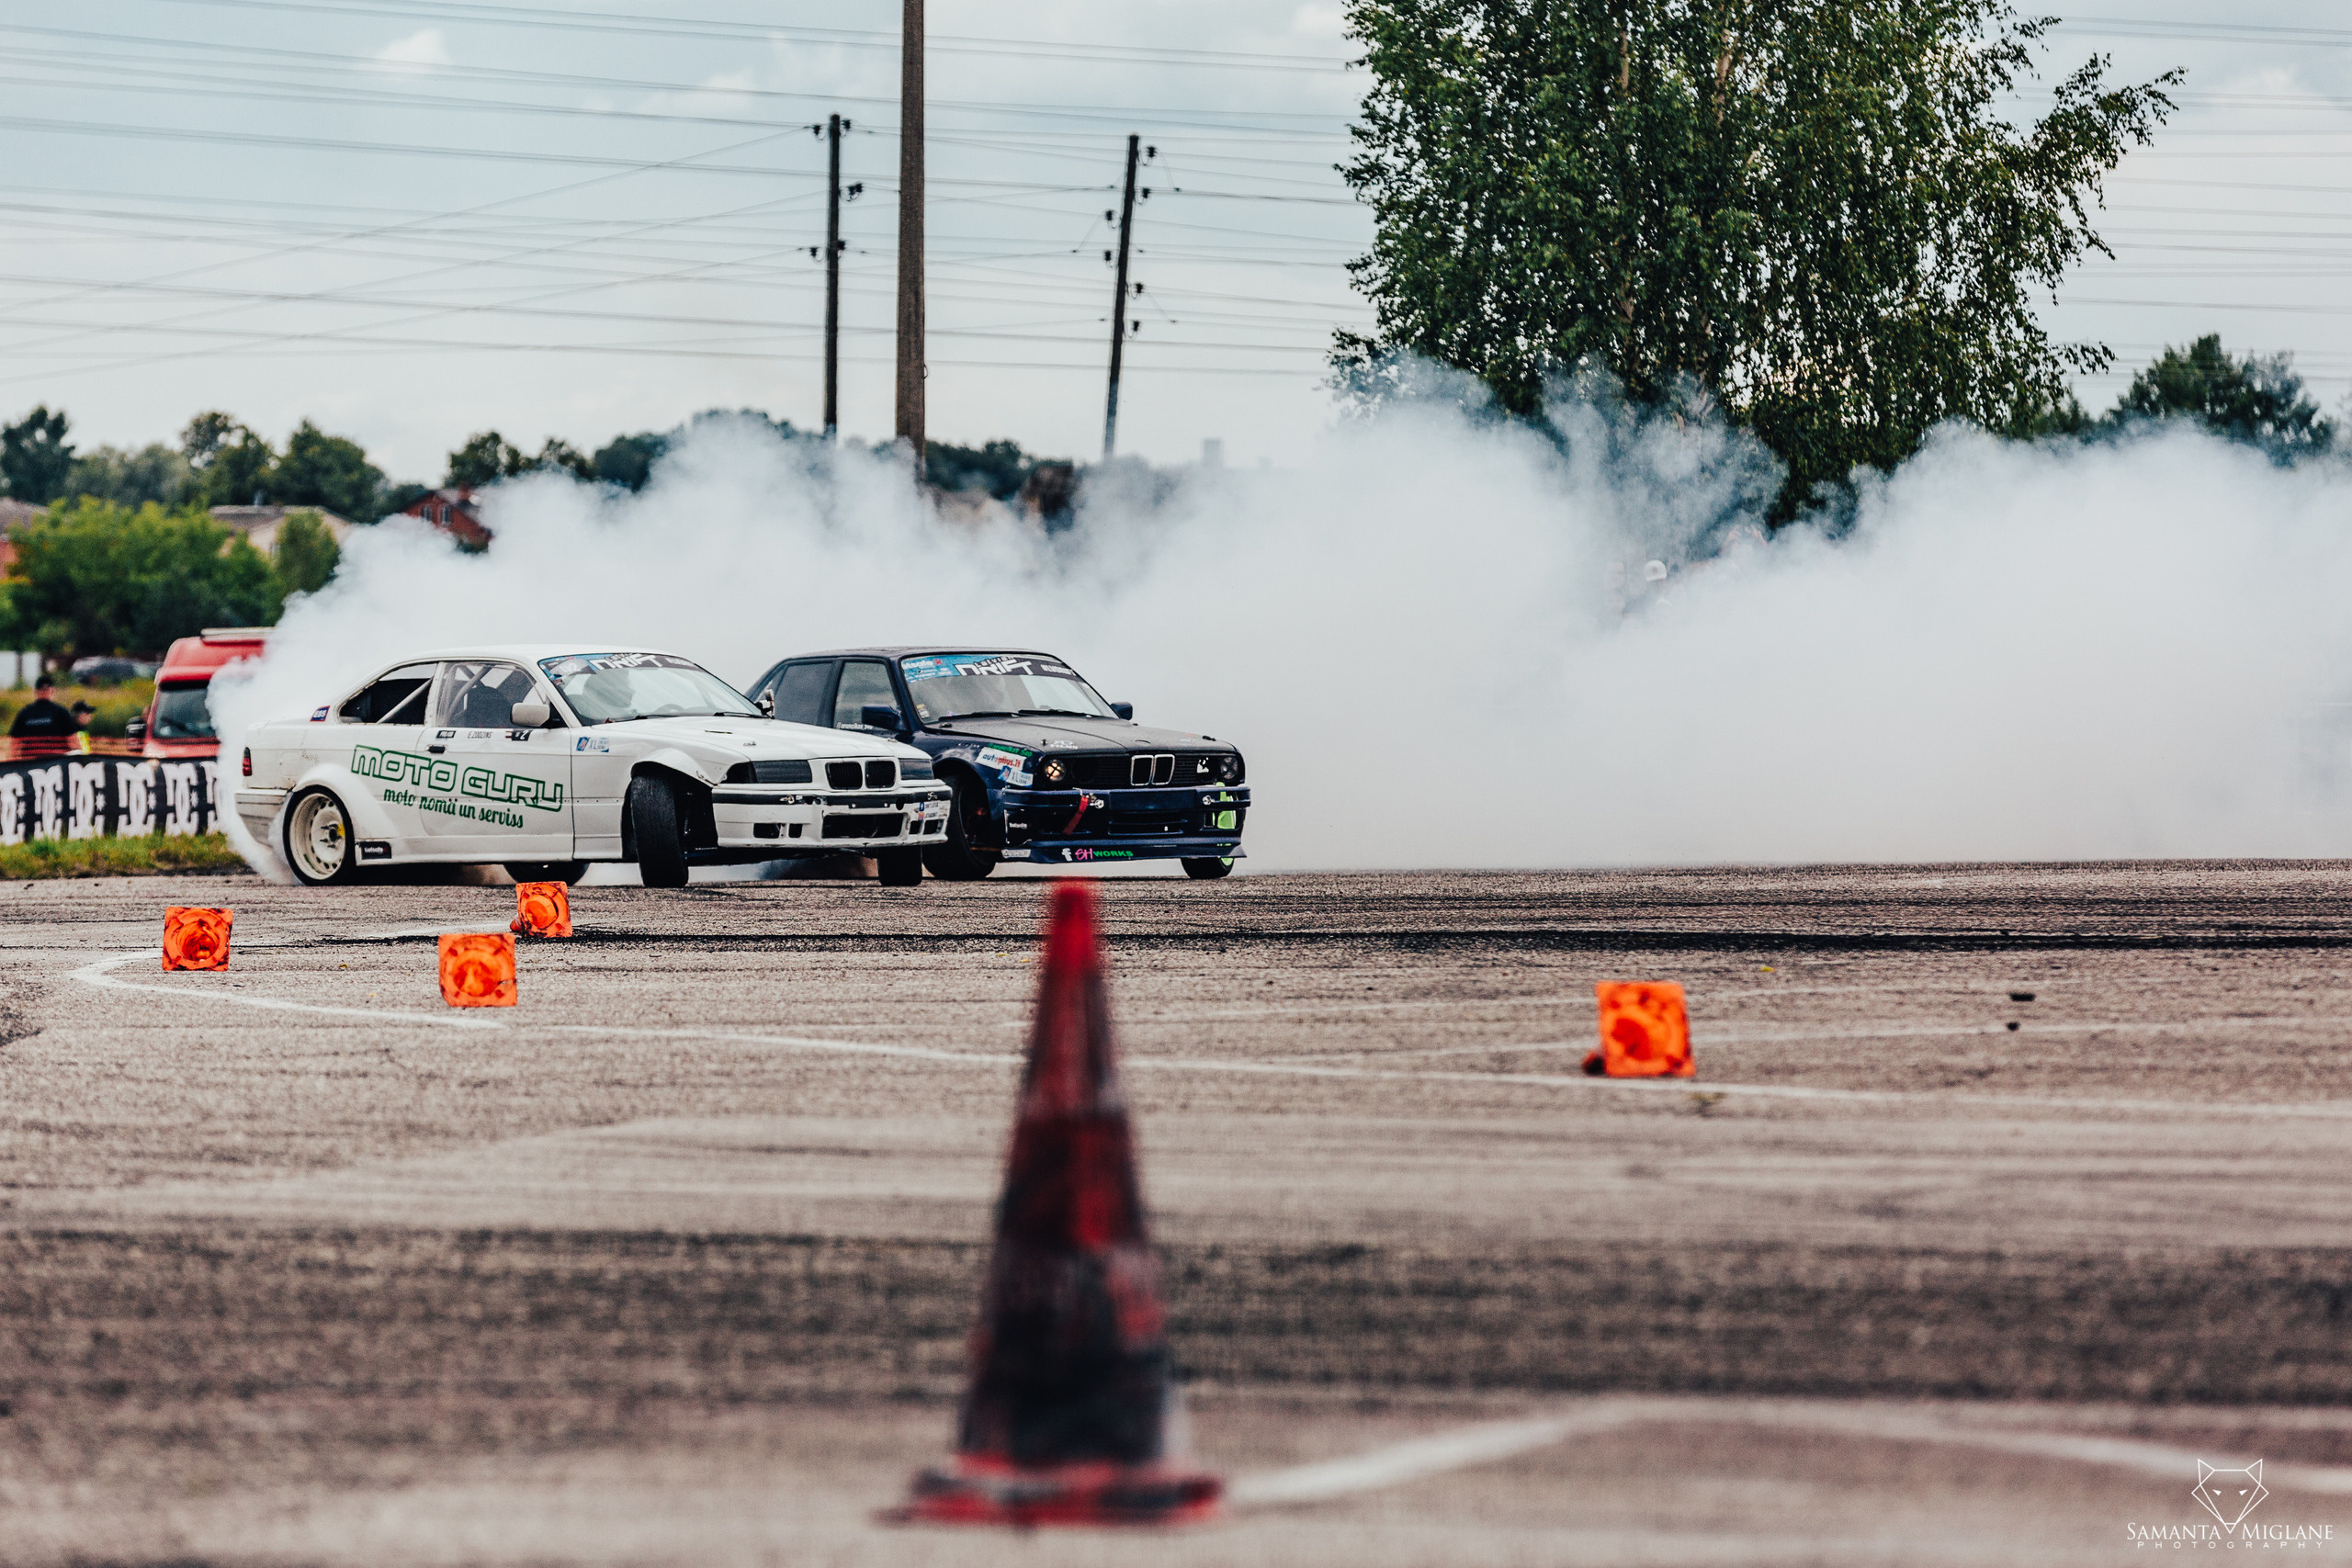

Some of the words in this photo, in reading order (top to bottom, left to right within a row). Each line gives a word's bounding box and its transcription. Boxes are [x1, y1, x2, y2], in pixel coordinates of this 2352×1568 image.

[351, 744, 458, 792] MOTO
[461, 766, 563, 813] GURU
[383, 788, 415, 807] moto
[459, 804, 476, 819] un
[479, 808, 524, 829] serviss
